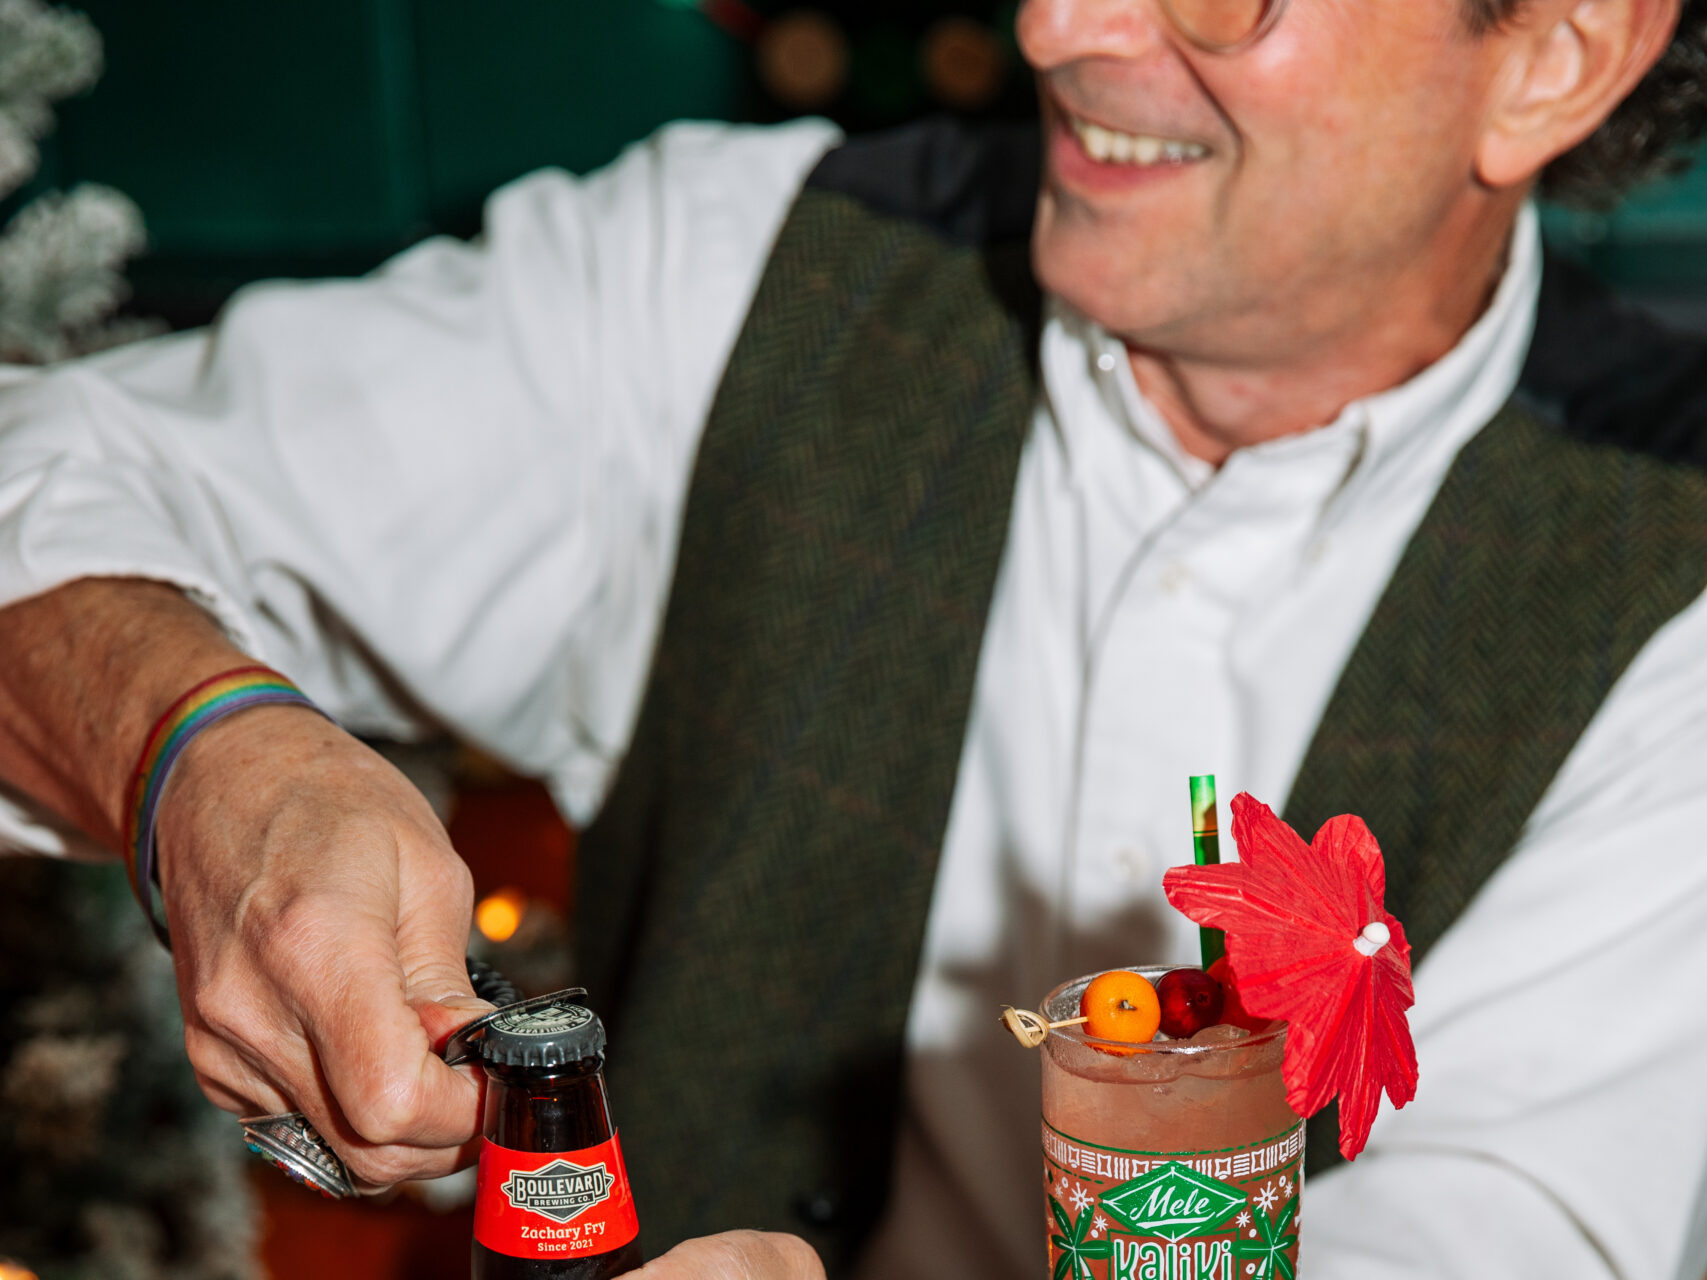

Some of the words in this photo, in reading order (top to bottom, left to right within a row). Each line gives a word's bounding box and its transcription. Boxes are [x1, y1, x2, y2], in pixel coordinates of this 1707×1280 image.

[516, 1172, 604, 1202] BOULEVARD
[534, 1197, 576, 1206] BREWING
[578, 1195, 591, 1203] CO.
[1130, 1187, 1216, 1222] Mele
[521, 1226, 581, 1241] Zachary
[584, 1221, 606, 1236] Fry
[537, 1242, 568, 1252] Since
[569, 1239, 594, 1251] 2021
